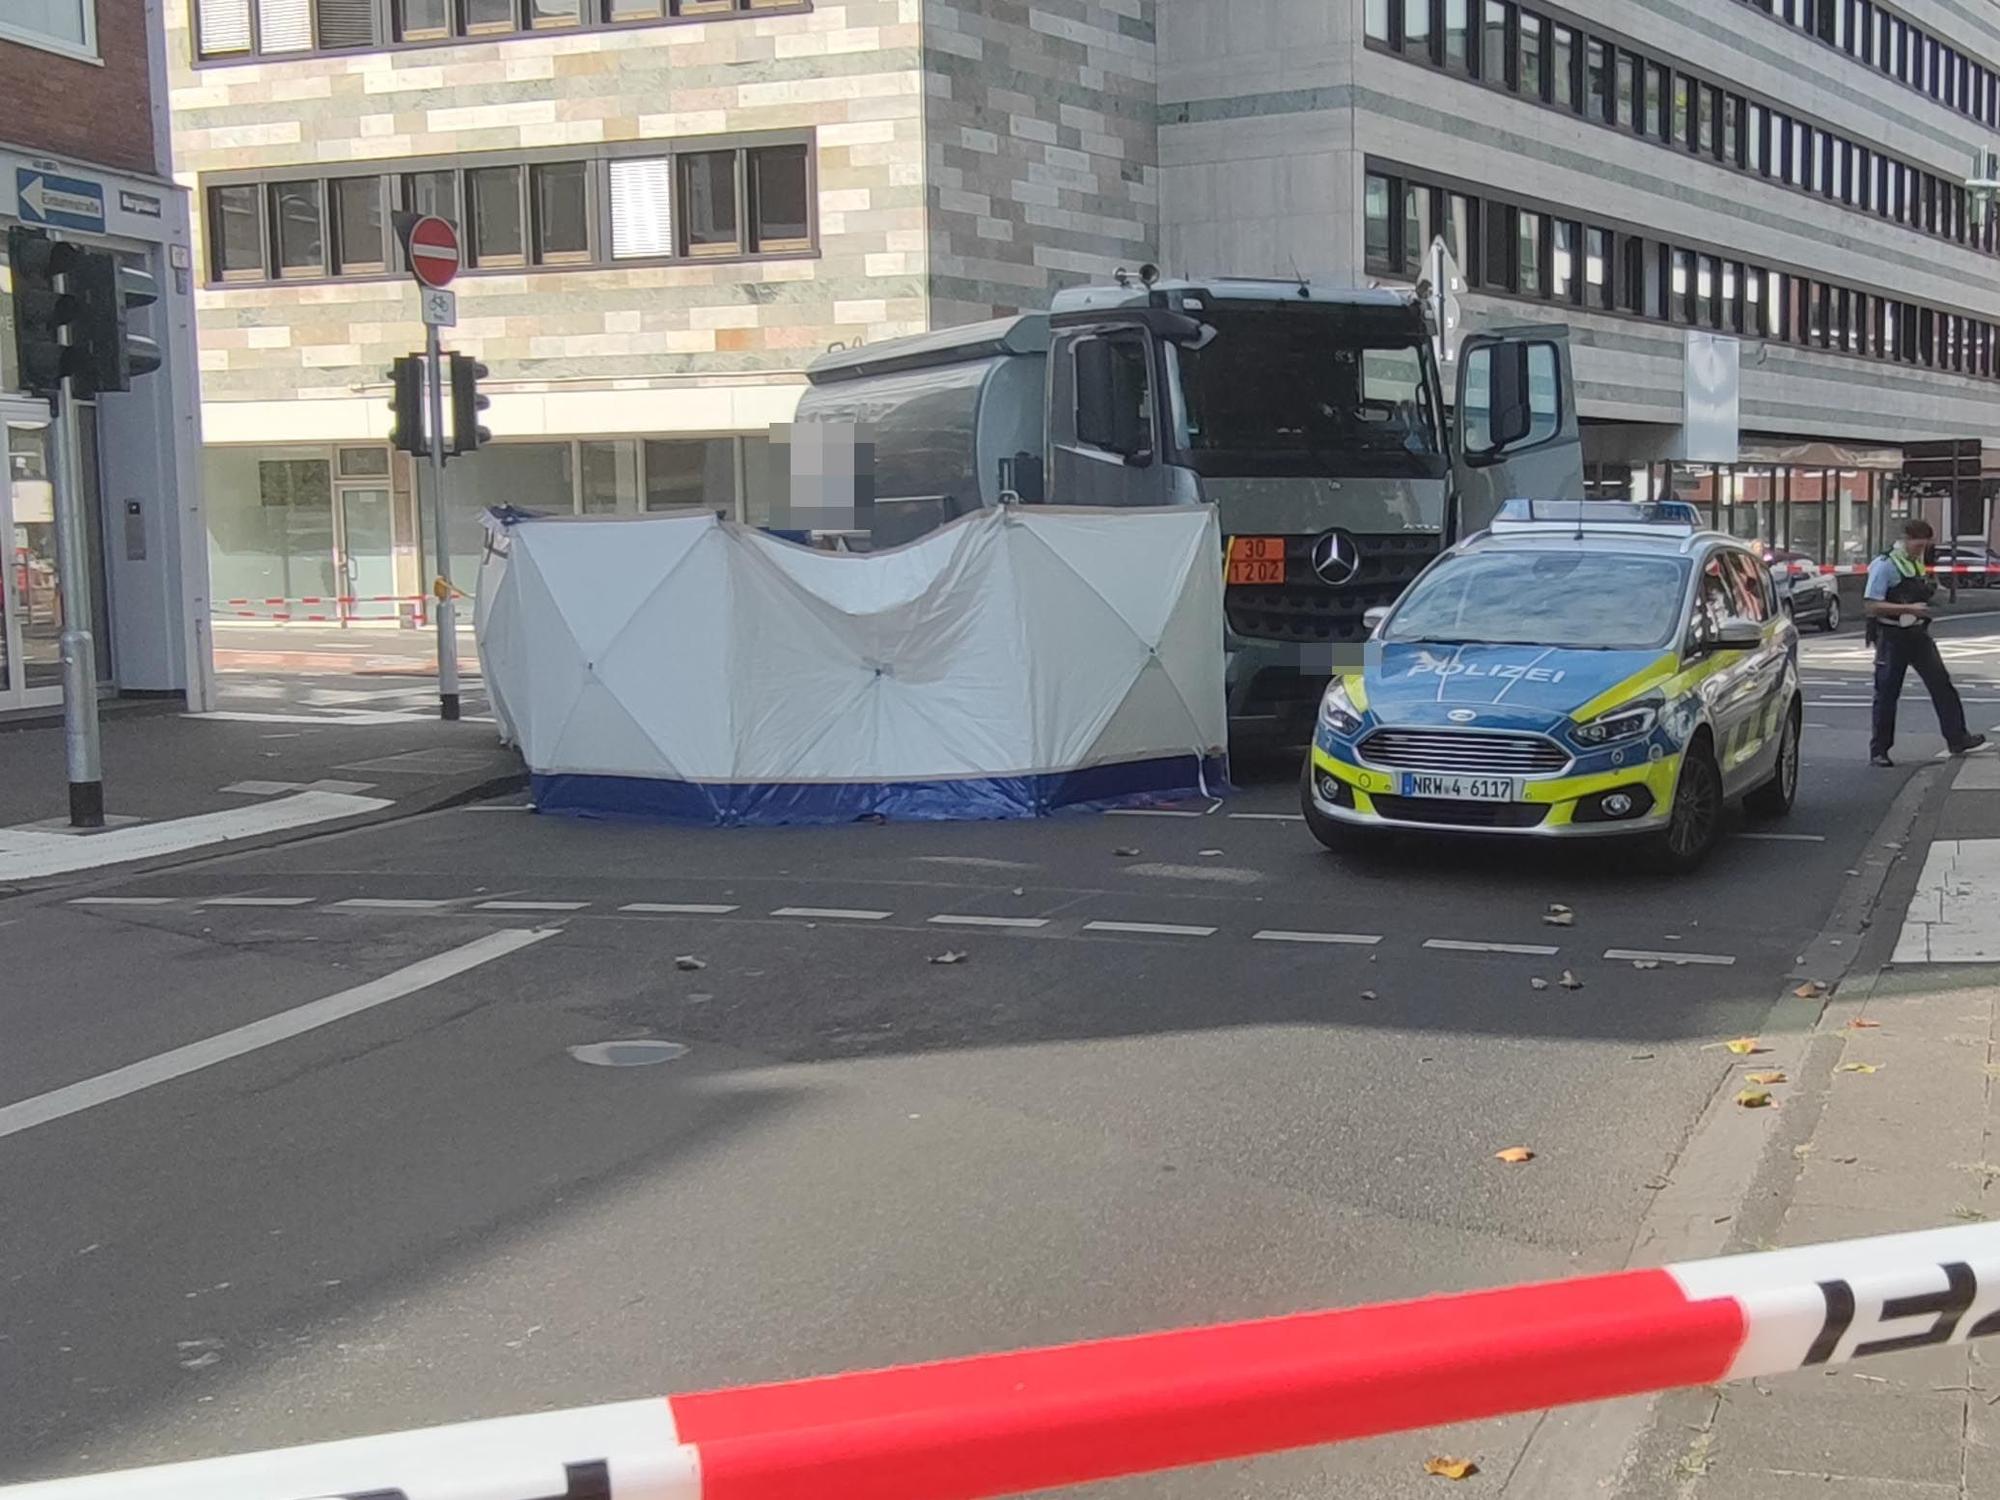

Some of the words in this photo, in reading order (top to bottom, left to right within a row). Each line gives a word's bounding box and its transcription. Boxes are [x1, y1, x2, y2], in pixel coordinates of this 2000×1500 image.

[1245, 539, 1267, 558] 30
[1233, 561, 1280, 582] 1202
[1407, 661, 1566, 684] POLIZEI
[1413, 776, 1443, 795] NRW
